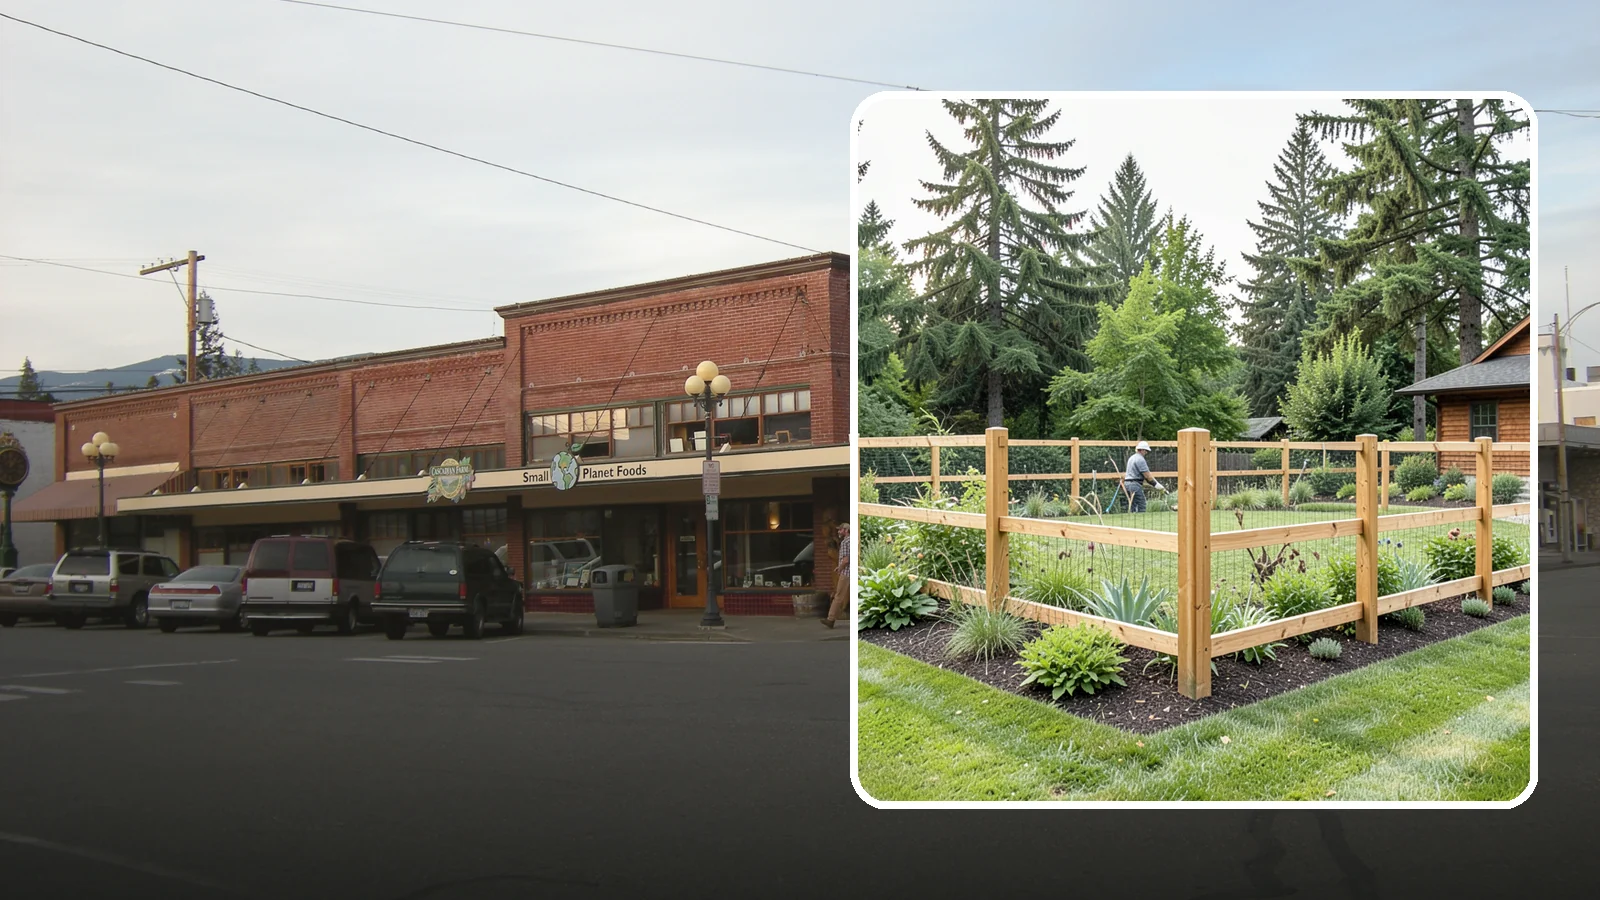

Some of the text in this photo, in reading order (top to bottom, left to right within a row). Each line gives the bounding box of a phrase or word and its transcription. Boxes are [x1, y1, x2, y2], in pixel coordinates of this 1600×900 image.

[523, 464, 647, 483] Small Planet Foods
